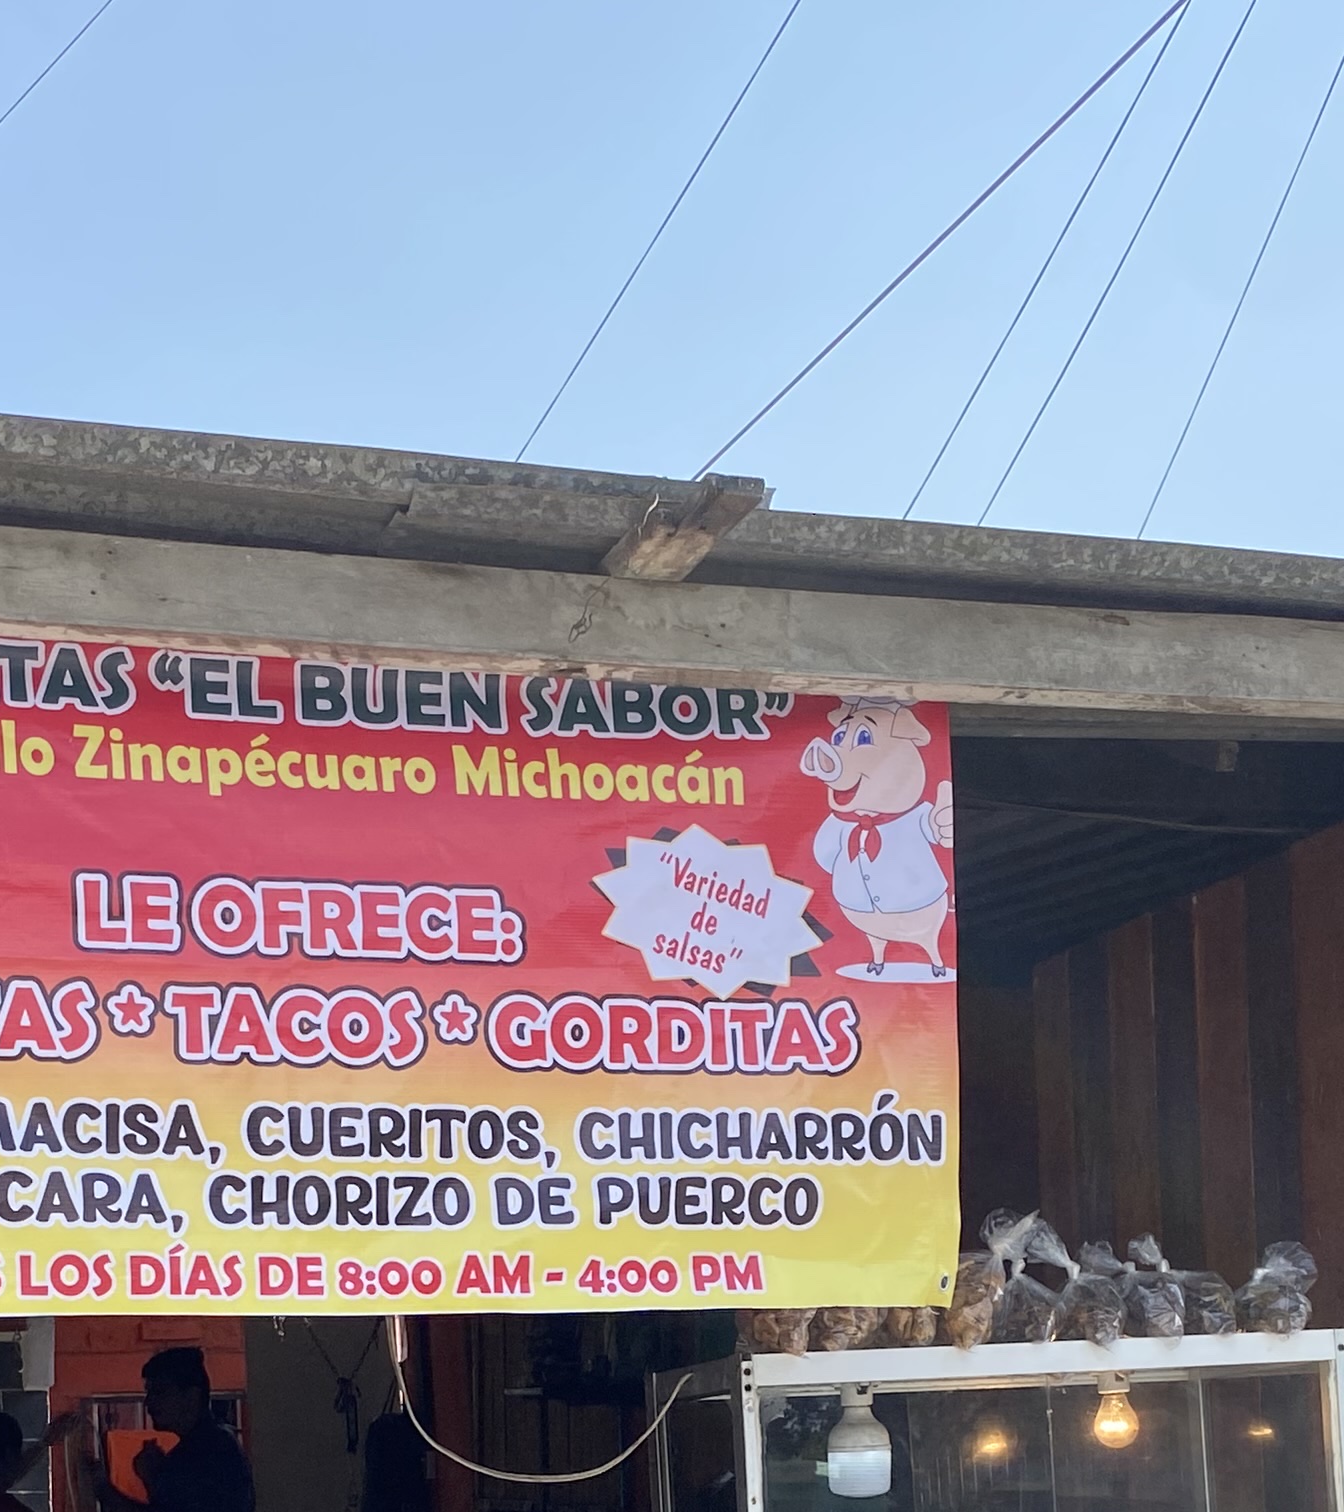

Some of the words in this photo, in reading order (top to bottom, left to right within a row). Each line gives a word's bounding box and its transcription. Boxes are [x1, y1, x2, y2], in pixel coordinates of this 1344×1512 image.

[298, 663, 503, 730] BUEN
[73, 724, 436, 796] Zinapécuaro
[453, 744, 745, 806] Michoacán
[76, 874, 180, 952] LE
[195, 878, 523, 960] OFRECE:
[691, 909, 717, 937] de
[166, 985, 422, 1066] TACOS
[488, 997, 859, 1072] GORDITAS
[244, 1105, 557, 1169] CUERITOS,
[577, 1091, 945, 1163] CHICHARRÓN
[209, 1173, 471, 1227] CHORIZO
[496, 1175, 575, 1227] DE
[597, 1175, 820, 1227] PUERCO
[19, 1251, 113, 1298] LOS
[127, 1243, 244, 1298] DÍAS
[257, 1254, 326, 1297] DE
[336, 1255, 443, 1296] 8:00
[454, 1253, 533, 1295] AM
[577, 1255, 682, 1294] 4:00
[691, 1253, 766, 1293] PM
